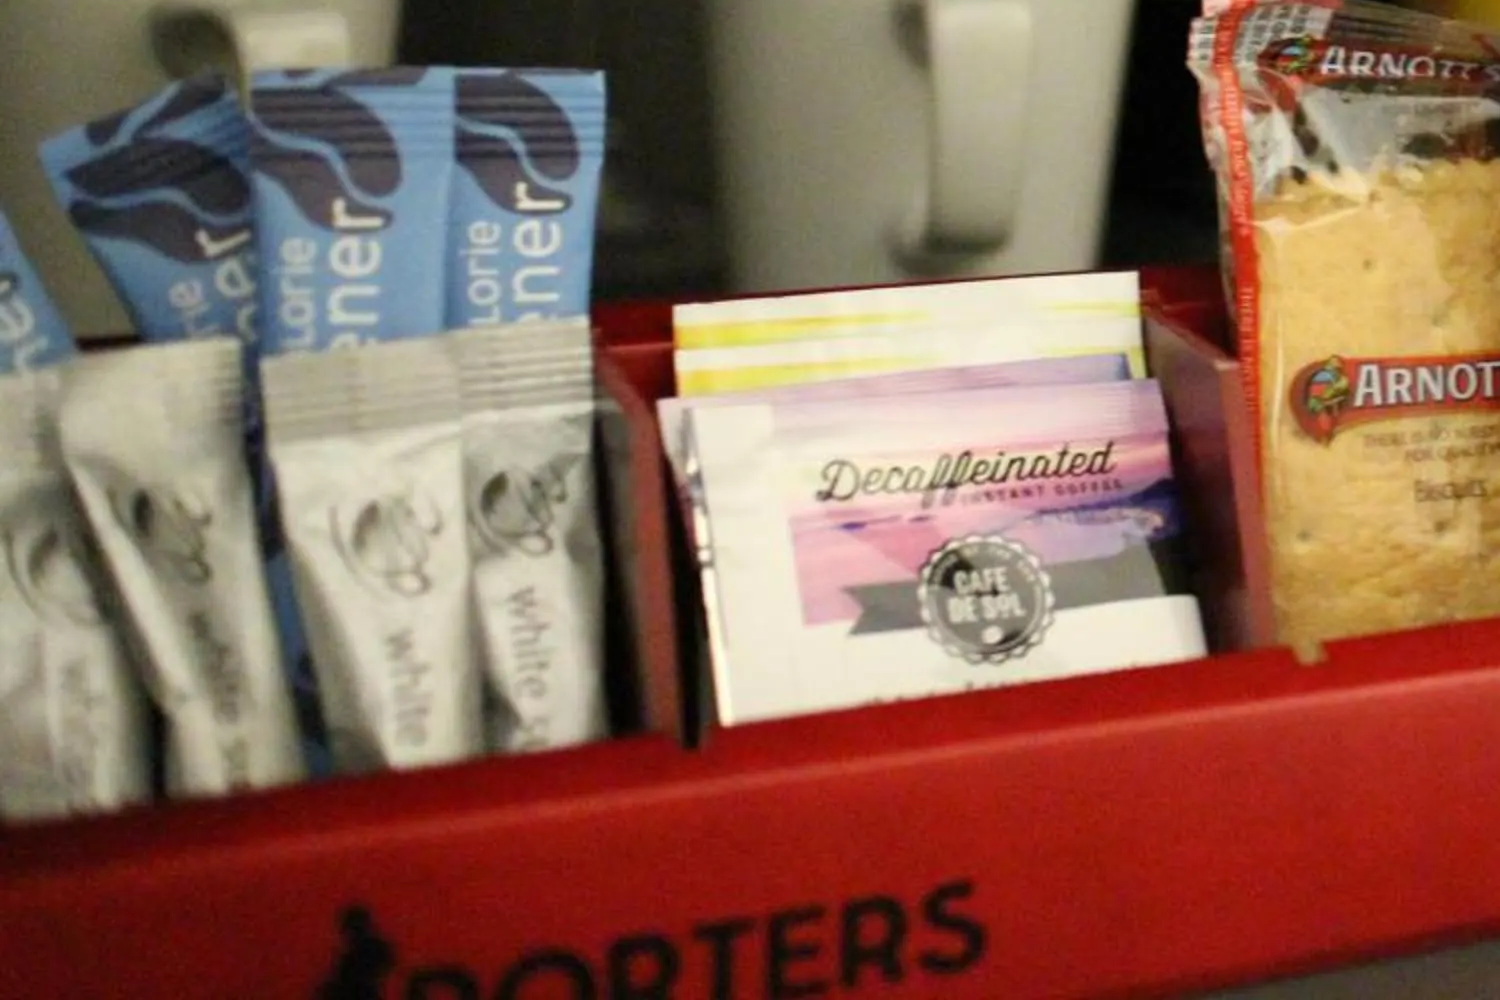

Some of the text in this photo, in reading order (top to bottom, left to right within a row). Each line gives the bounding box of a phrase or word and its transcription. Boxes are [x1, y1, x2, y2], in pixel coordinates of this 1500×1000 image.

[815, 440, 1117, 509] Decaffeinated
[1055, 477, 1125, 497] COFFEE
[953, 566, 1012, 595] CAFE
